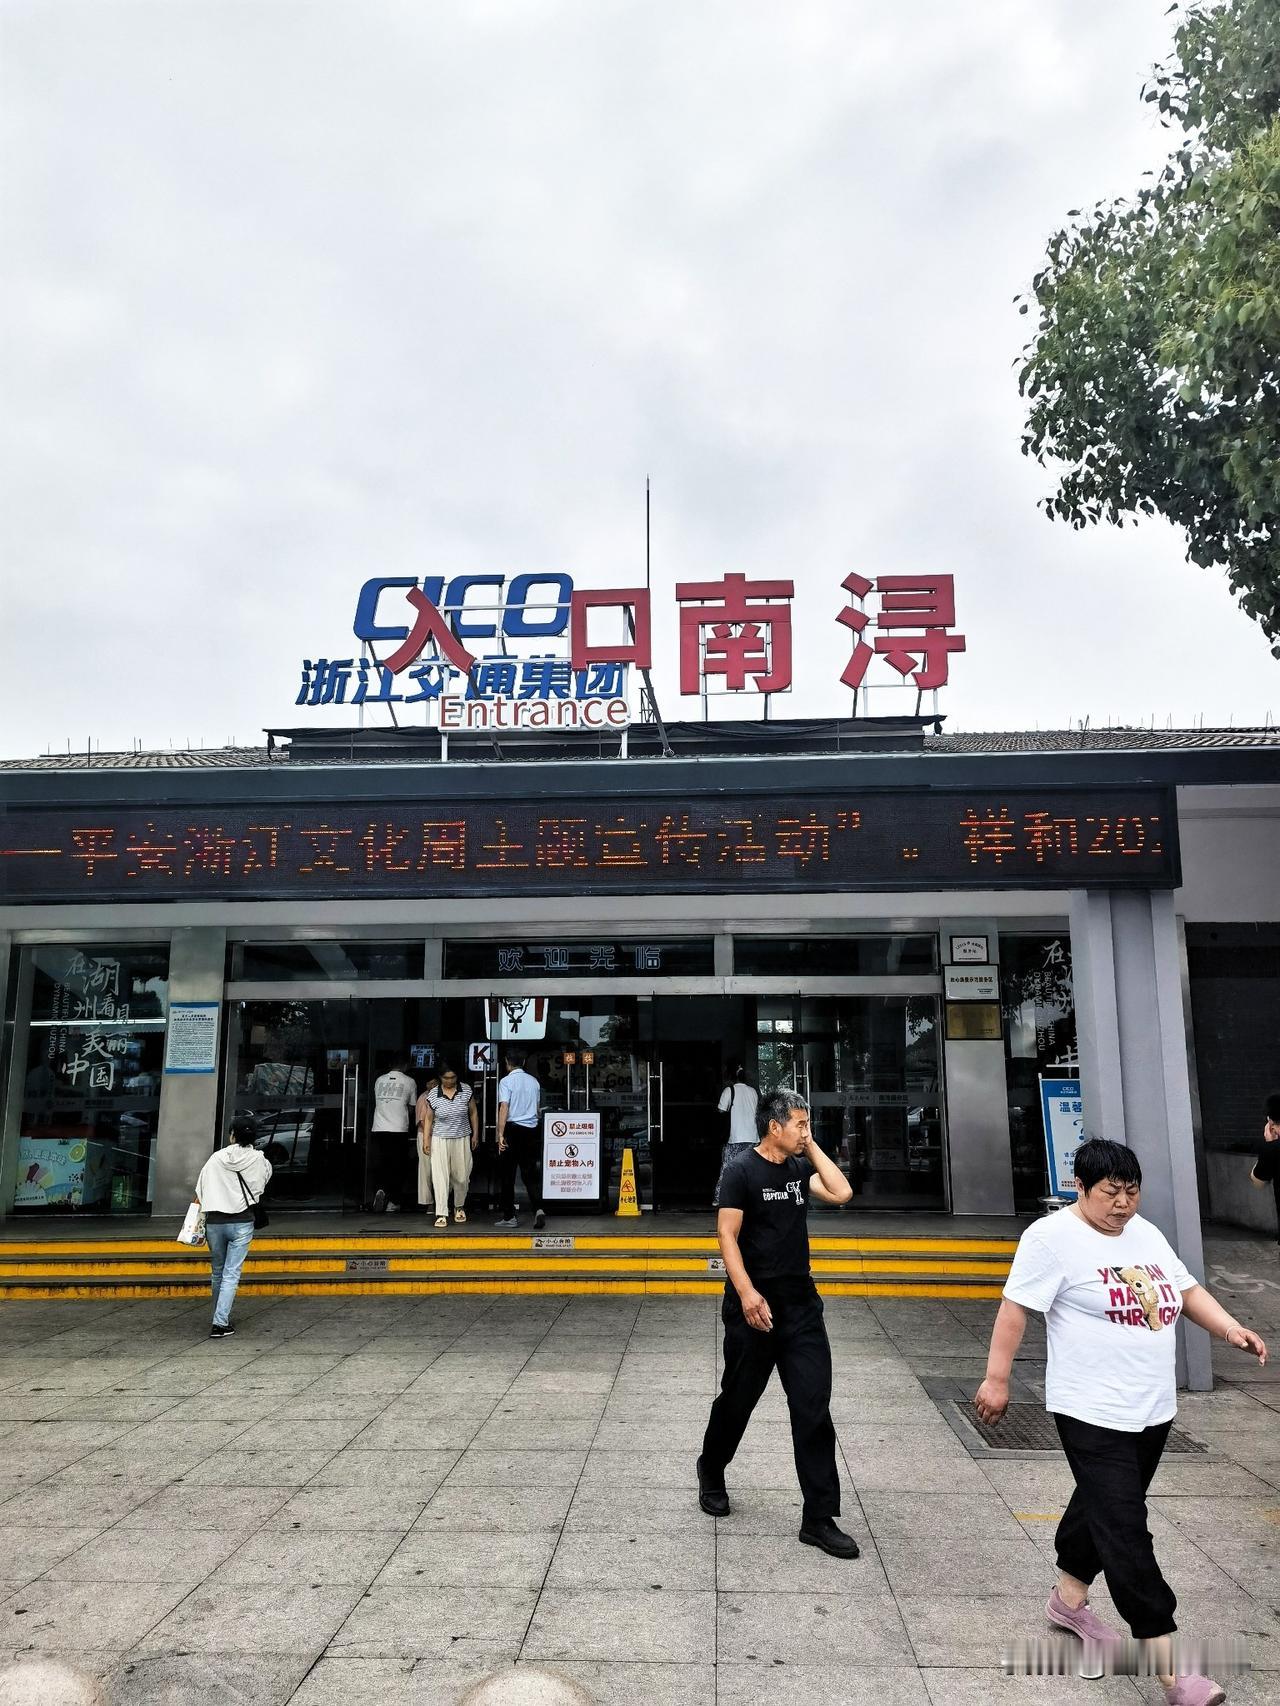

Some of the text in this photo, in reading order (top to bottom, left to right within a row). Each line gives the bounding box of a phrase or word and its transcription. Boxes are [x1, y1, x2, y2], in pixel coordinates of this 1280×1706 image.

[383, 586, 652, 676] 入口
[675, 572, 967, 697] 南浔
[440, 695, 628, 729] Entrance
[498, 945, 661, 972] 欢迎光临
[61, 1053, 115, 1091] 中国
[549, 1159, 594, 1168] 禁止宠物入内
[1158, 1283, 1177, 1303] IT
